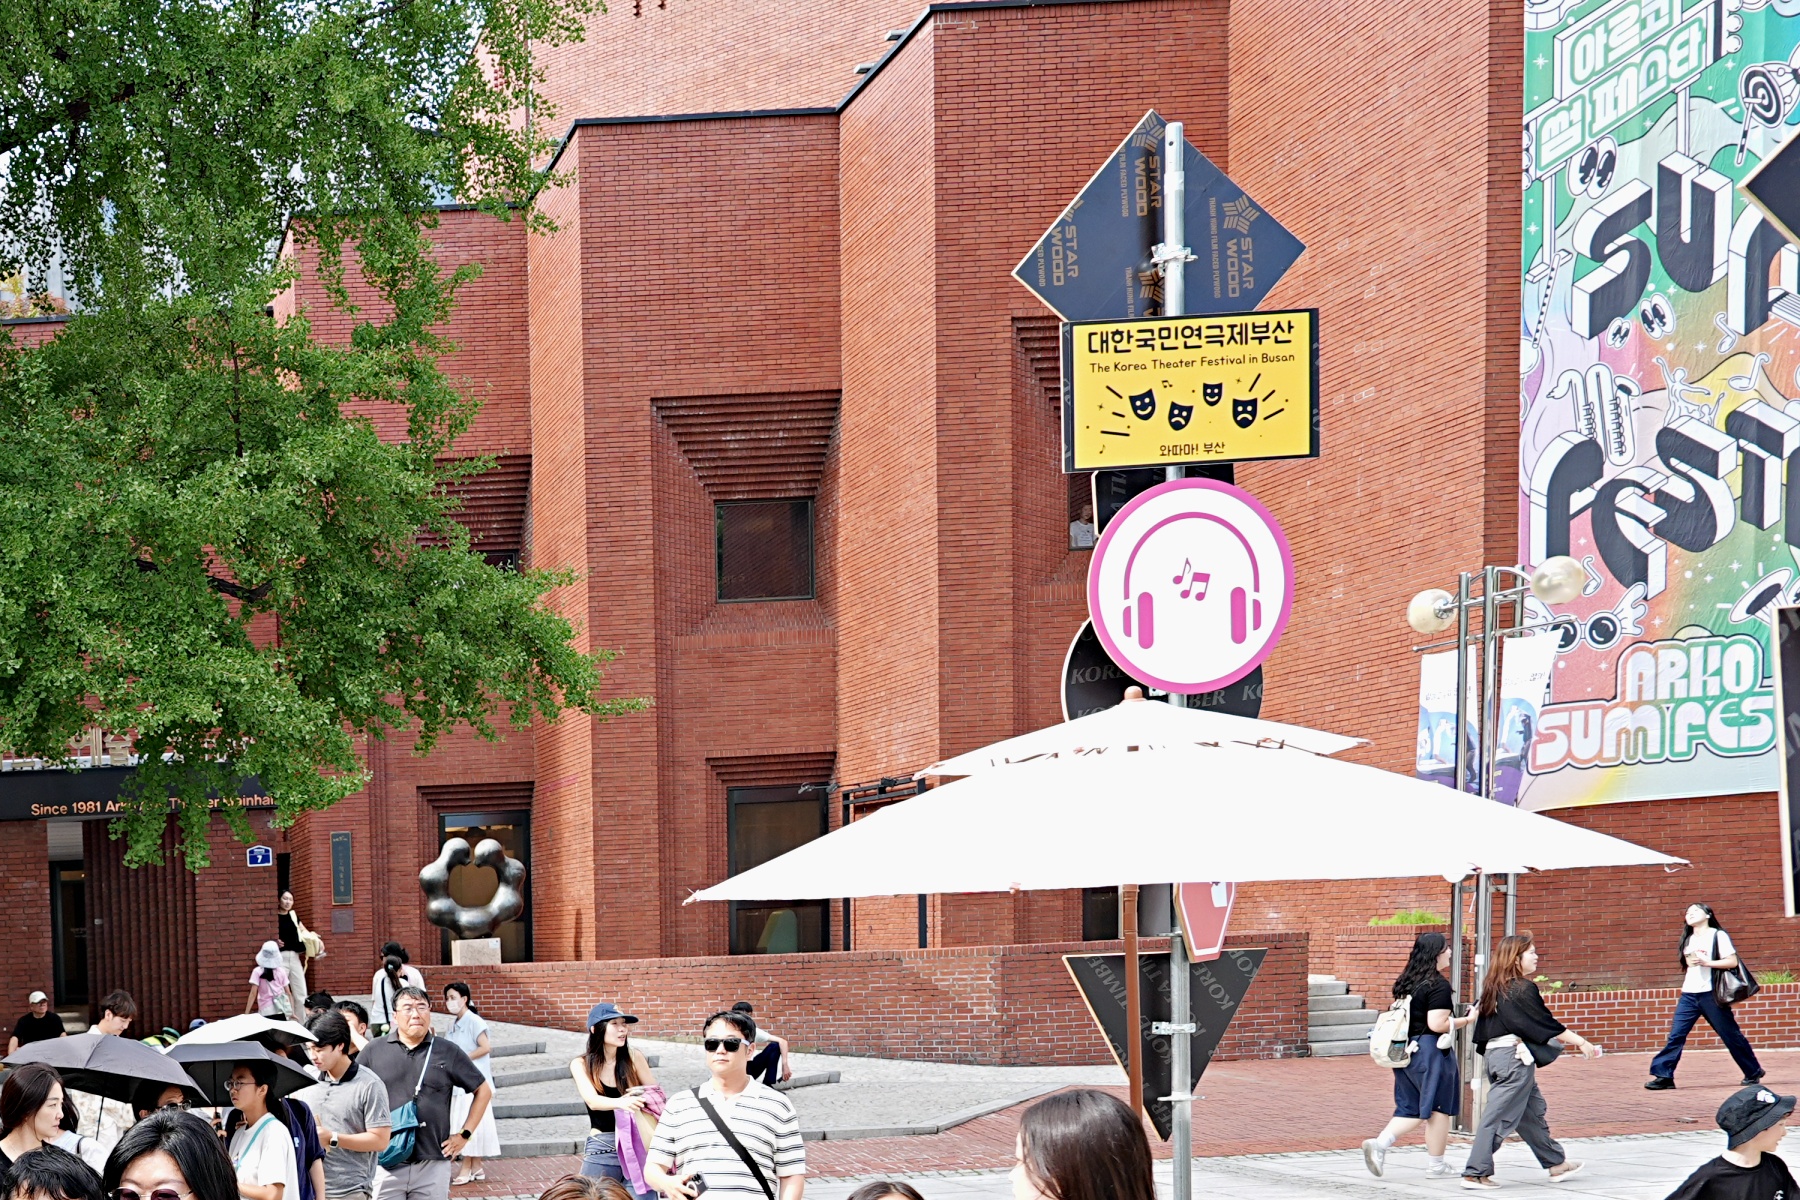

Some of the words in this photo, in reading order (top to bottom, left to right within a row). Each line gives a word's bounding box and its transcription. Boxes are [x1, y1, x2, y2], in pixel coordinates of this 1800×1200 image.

[1120, 189, 1129, 217] PLYWOOD
[1134, 157, 1148, 217] WOOD
[1148, 155, 1162, 208] STAR
[1037, 258, 1045, 287] PLYWOOD
[1051, 226, 1065, 286] WOOD
[1065, 225, 1079, 278] STAR
[1226, 238, 1240, 298] WOOD
[1241, 237, 1254, 289] STAR
[1212, 270, 1221, 299] PLYWOOD
[1088, 320, 1294, 354] 대한국민연극제부산
[1089, 362, 1111, 374] The
[1114, 360, 1147, 372] Korea
[1151, 358, 1196, 370] Theater
[1200, 354, 1246, 367] Festival
[1249, 353, 1258, 364] in
[1261, 352, 1295, 364] Busan
[1159, 443, 1199, 457] 와따마!
[1203, 442, 1226, 455] 부산
[1529, 398, 1800, 601] FEST
[1071, 662, 1124, 685] KORE
[1625, 641, 1757, 702] ARKO
[1533, 702, 1666, 770] SUM
[1667, 694, 1774, 758] FES
[31, 802, 68, 816] Since
[72, 801, 101, 814] 1981
[256, 855, 263, 863] 7
